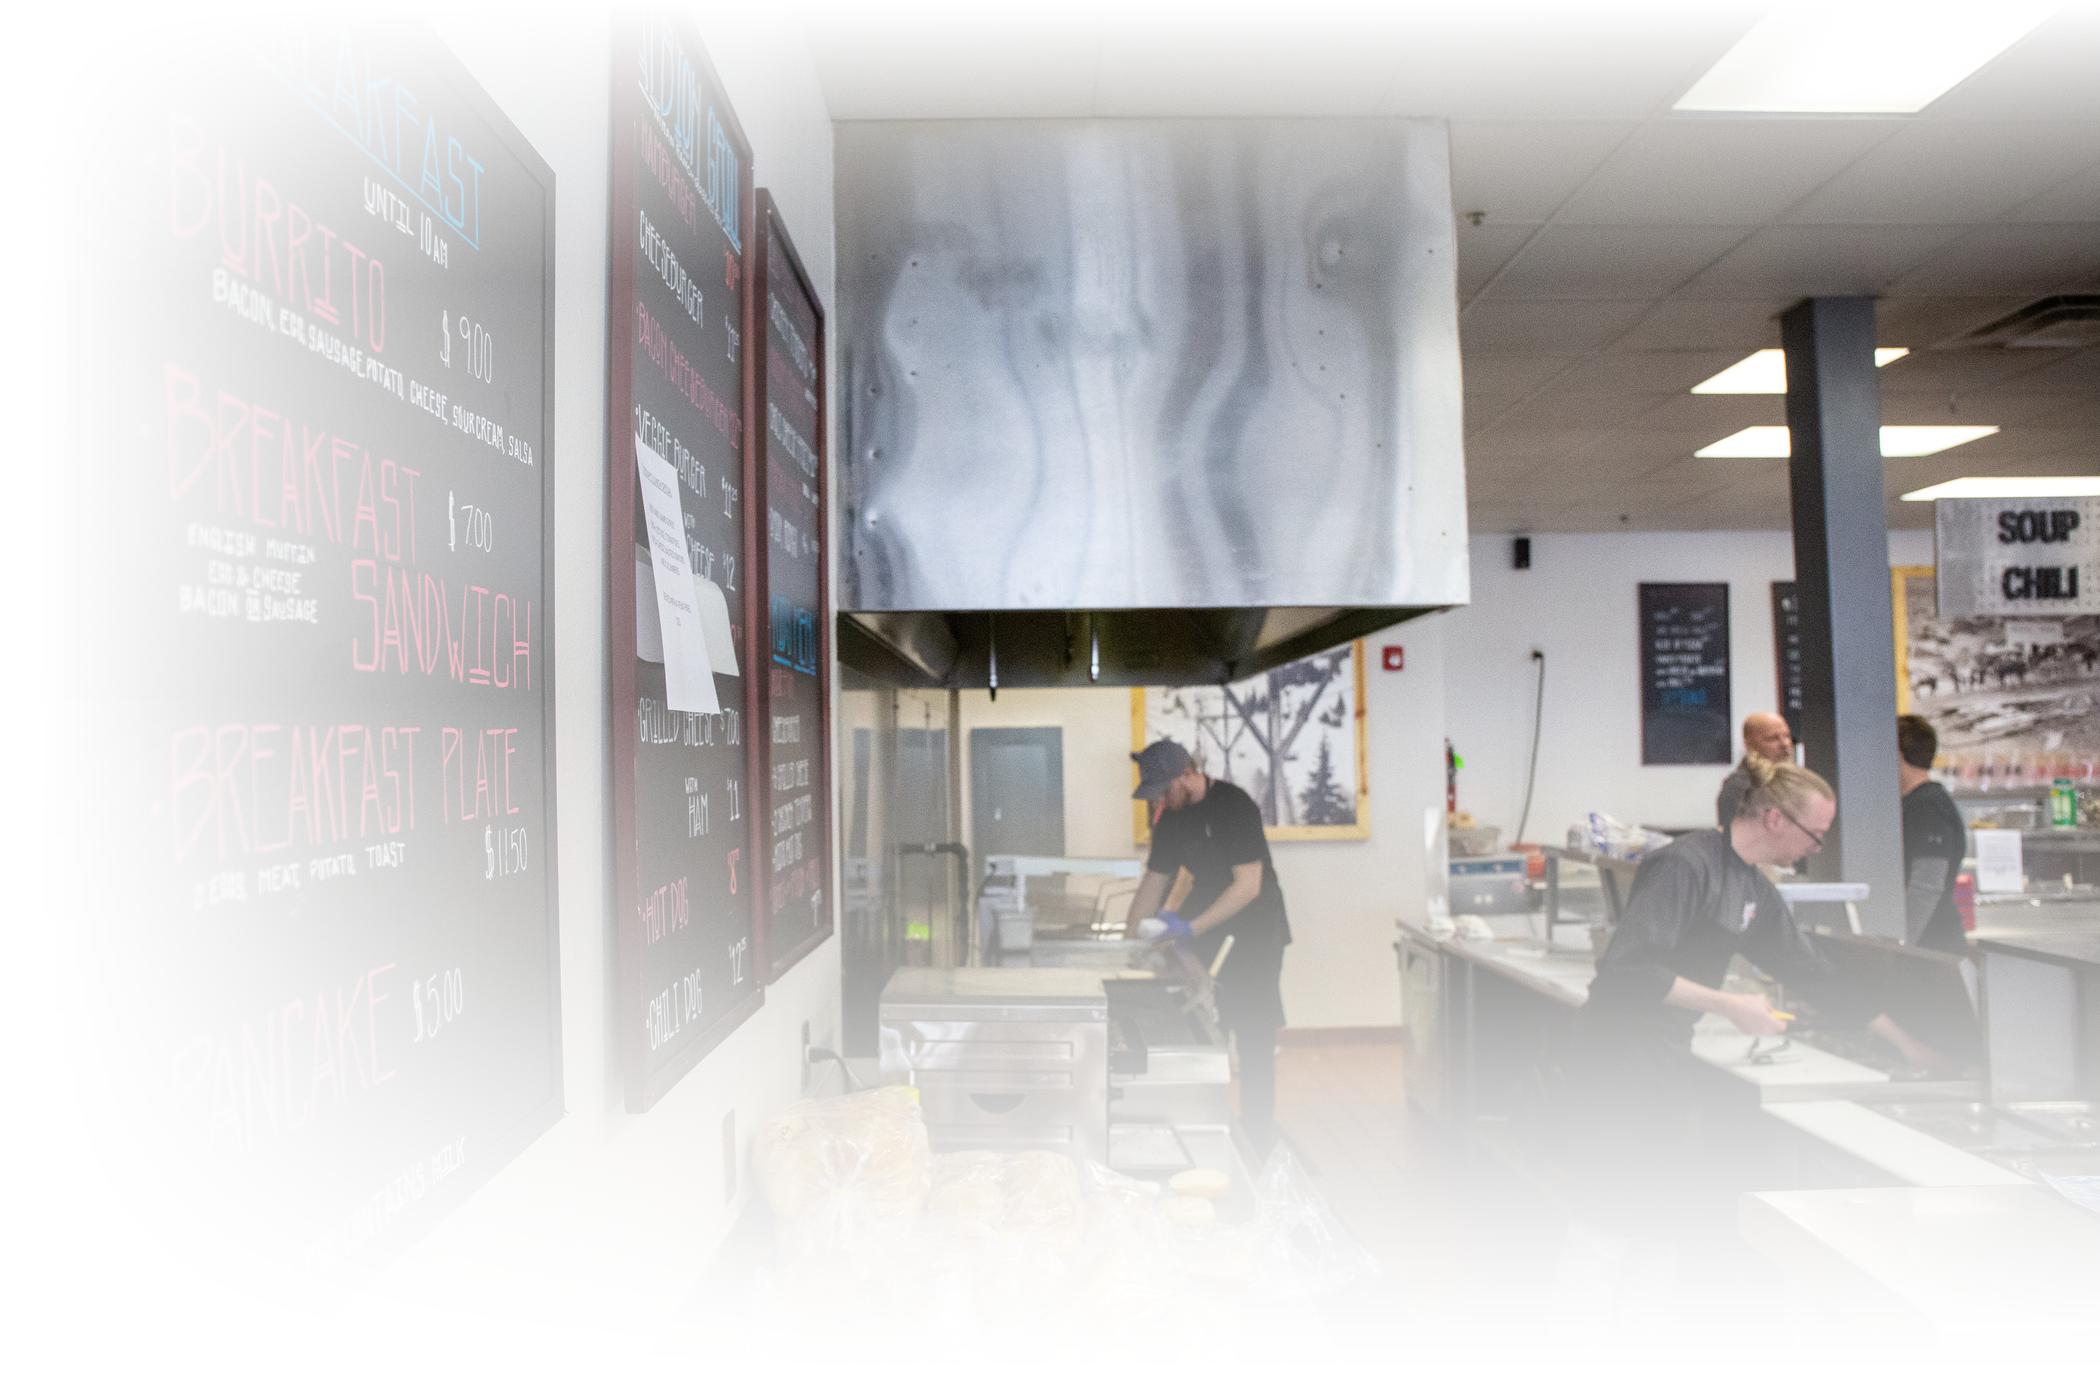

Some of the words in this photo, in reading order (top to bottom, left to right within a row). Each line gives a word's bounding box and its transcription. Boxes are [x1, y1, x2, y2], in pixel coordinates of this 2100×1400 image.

[168, 112, 386, 353] BURRITO
[364, 176, 414, 236] UNTIL
[639, 210, 703, 329] CHEESEBURGER
[639, 302, 667, 381] BACON
[165, 361, 421, 565] BREAKFAST
[508, 434, 534, 467] SALSA
[673, 437, 706, 498] BURGER
[186, 521, 257, 557] ENGLISH
[1998, 510, 2080, 544] SOUP
[178, 585, 239, 617] BACON
[263, 595, 318, 624] SAUSAGE
[252, 565, 304, 596] CHEESE
[2002, 566, 2078, 600] CHILI
[352, 560, 531, 691] SANDWICH
[172, 723, 421, 864] BREAKFAST
[441, 727, 520, 824] PLATE
[688, 792, 709, 838] HAM
[365, 842, 406, 871] TOAST
[645, 885, 667, 944] HOT
[671, 877, 689, 930] DOG
[648, 982, 681, 1051] CHILI
[684, 967, 704, 1022] DOG
[170, 961, 398, 1153] PANCAKE
